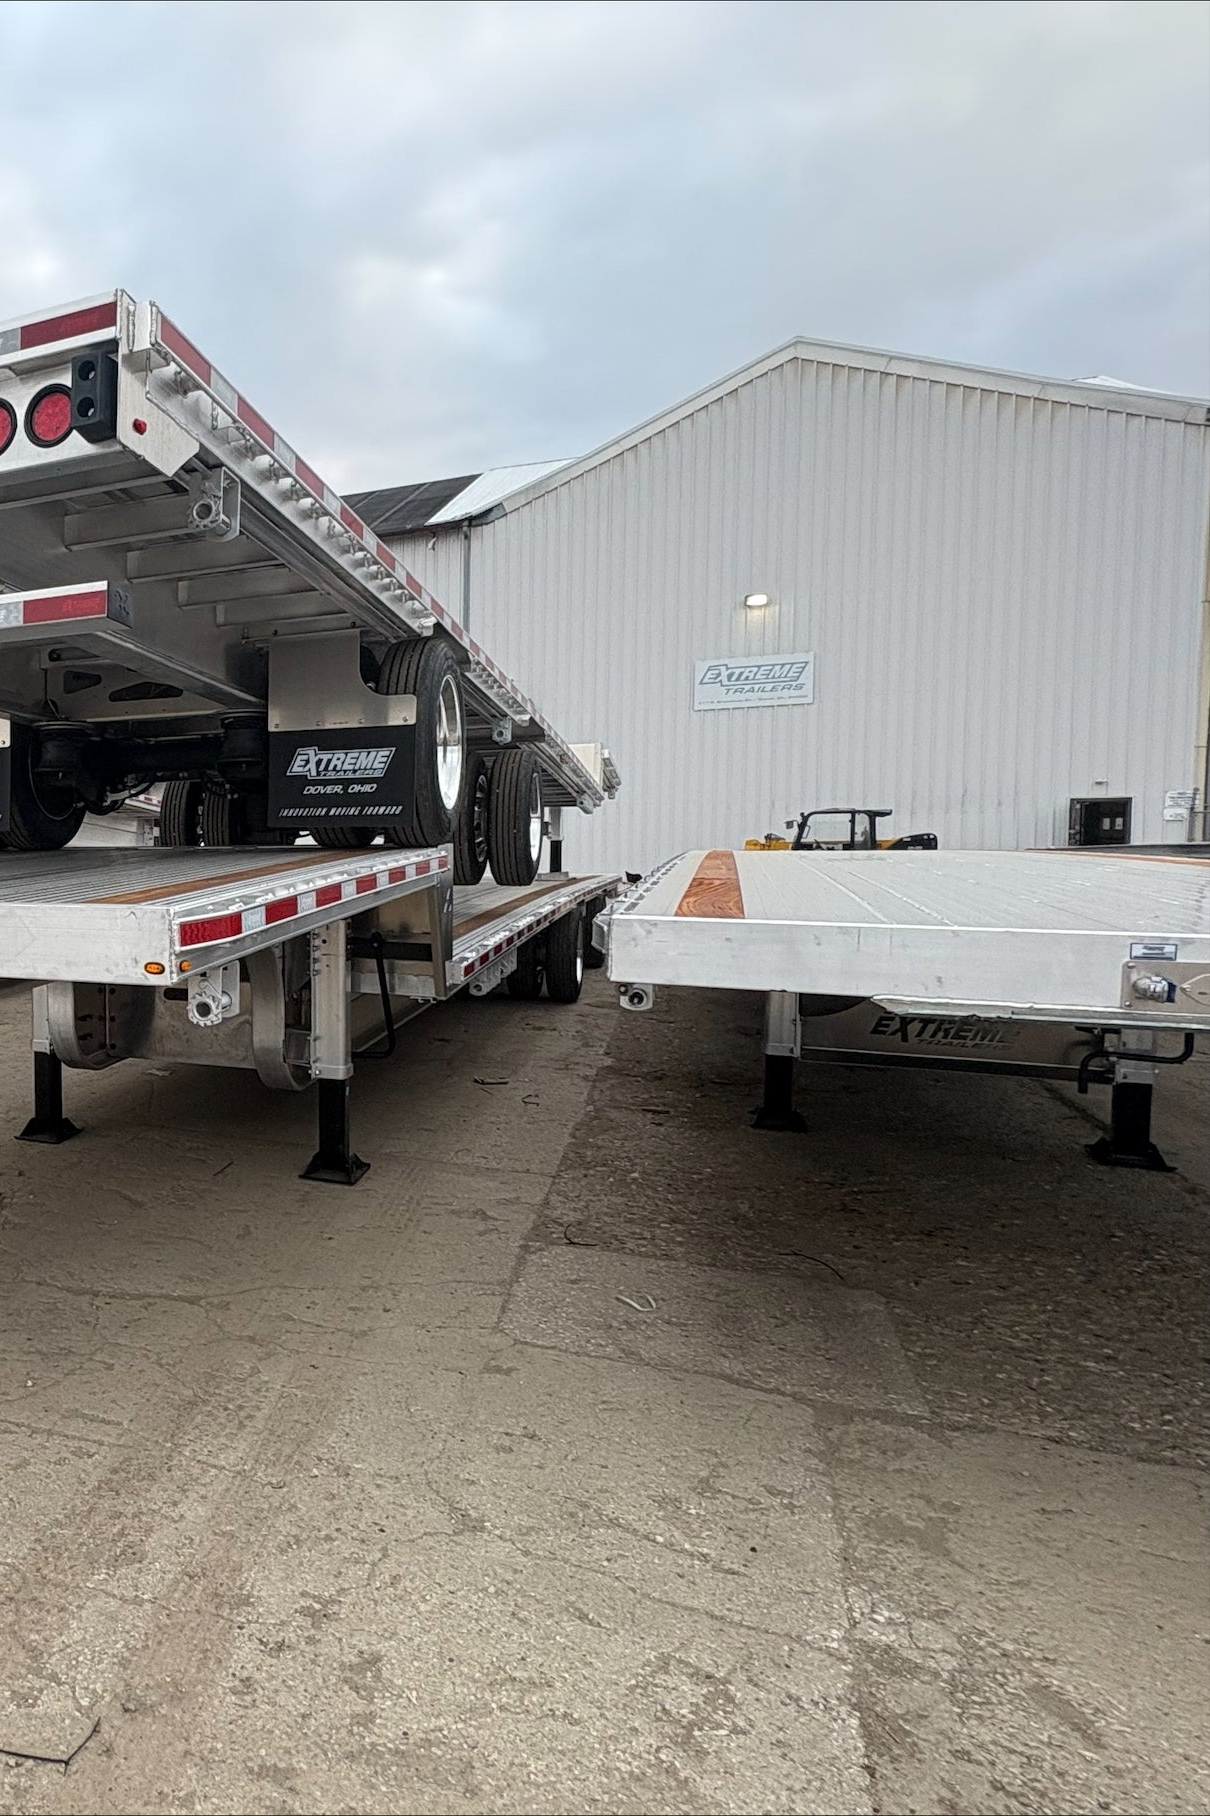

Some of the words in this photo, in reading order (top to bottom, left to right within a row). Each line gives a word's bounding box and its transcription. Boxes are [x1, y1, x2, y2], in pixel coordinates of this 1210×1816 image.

[701, 662, 808, 685] EXTREME
[725, 683, 806, 695] TRAILERS
[291, 749, 390, 776] EXTREME
[320, 768, 384, 776] TRAILERS
[303, 784, 344, 794] DOVER,
[348, 783, 378, 793] OHIO
